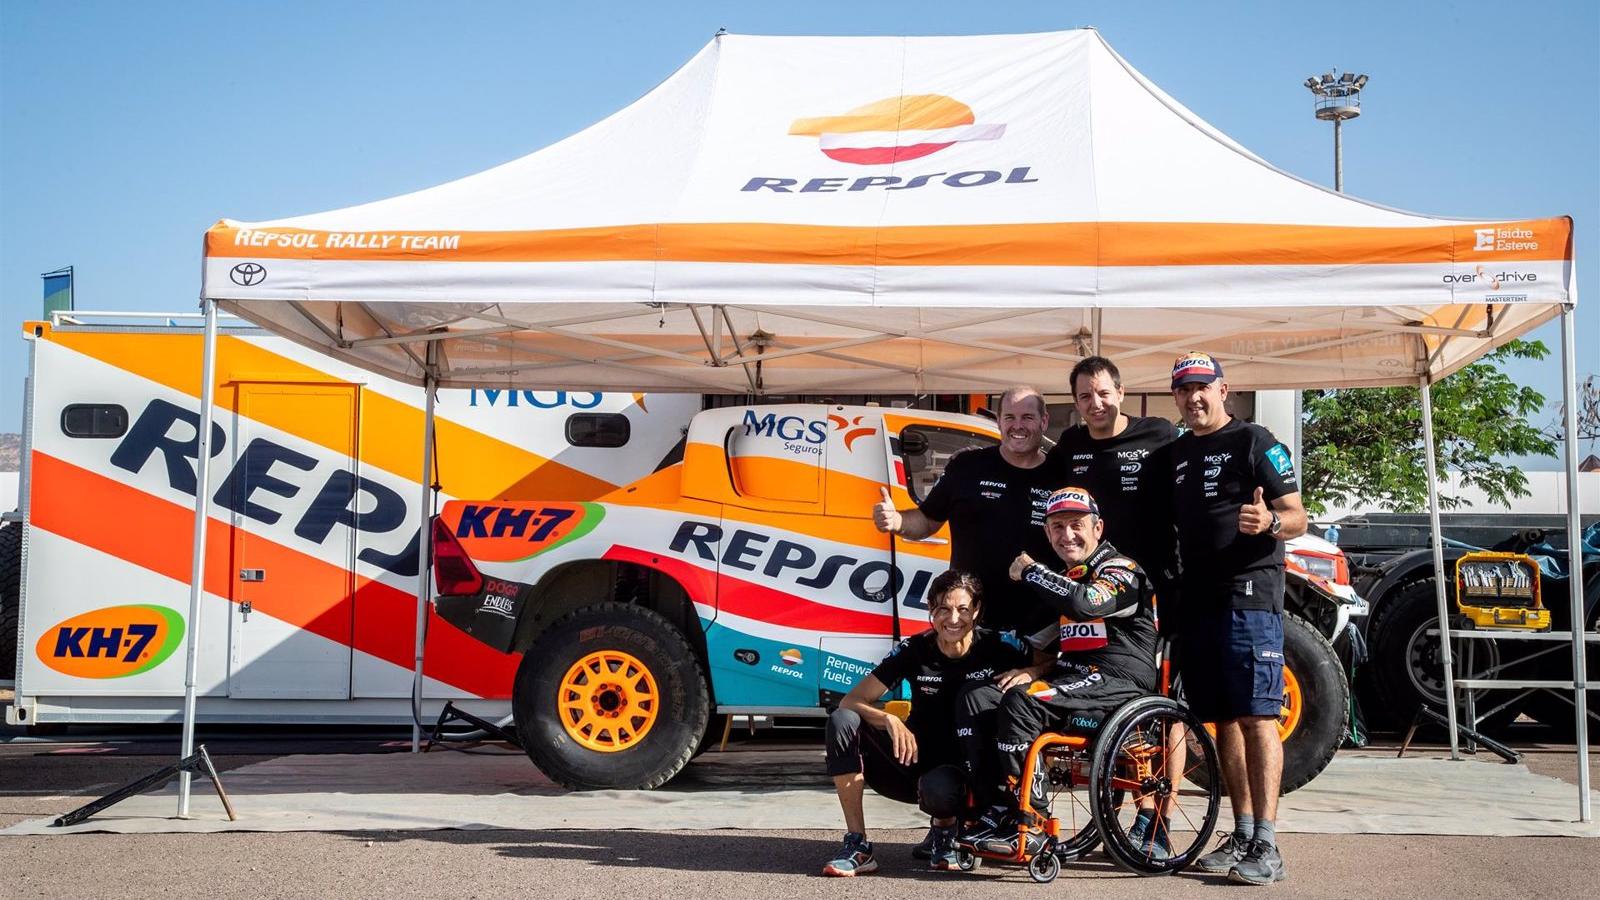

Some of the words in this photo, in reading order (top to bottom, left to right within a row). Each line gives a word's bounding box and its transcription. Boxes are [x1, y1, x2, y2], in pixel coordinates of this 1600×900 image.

[740, 167, 1039, 193] REPSOL
[235, 229, 319, 248] REPSOL
[325, 232, 396, 249] RALLY
[400, 234, 461, 249] TEAM
[1496, 228, 1533, 239] Isidre
[1496, 240, 1539, 251] Esteve
[1174, 358, 1210, 371] REPSOL
[743, 410, 827, 444] MGS
[784, 441, 823, 455] Seguros
[1117, 451, 1139, 459] MGS
[980, 480, 1007, 489] REPSOL
[1048, 492, 1086, 505] REPSOL
[668, 520, 933, 611] REPSOL
[1060, 624, 1099, 639] EPSOL
[771, 664, 803, 679] REPSOL
[826, 655, 876, 677] Renewa
[823, 668, 852, 685] fuels
